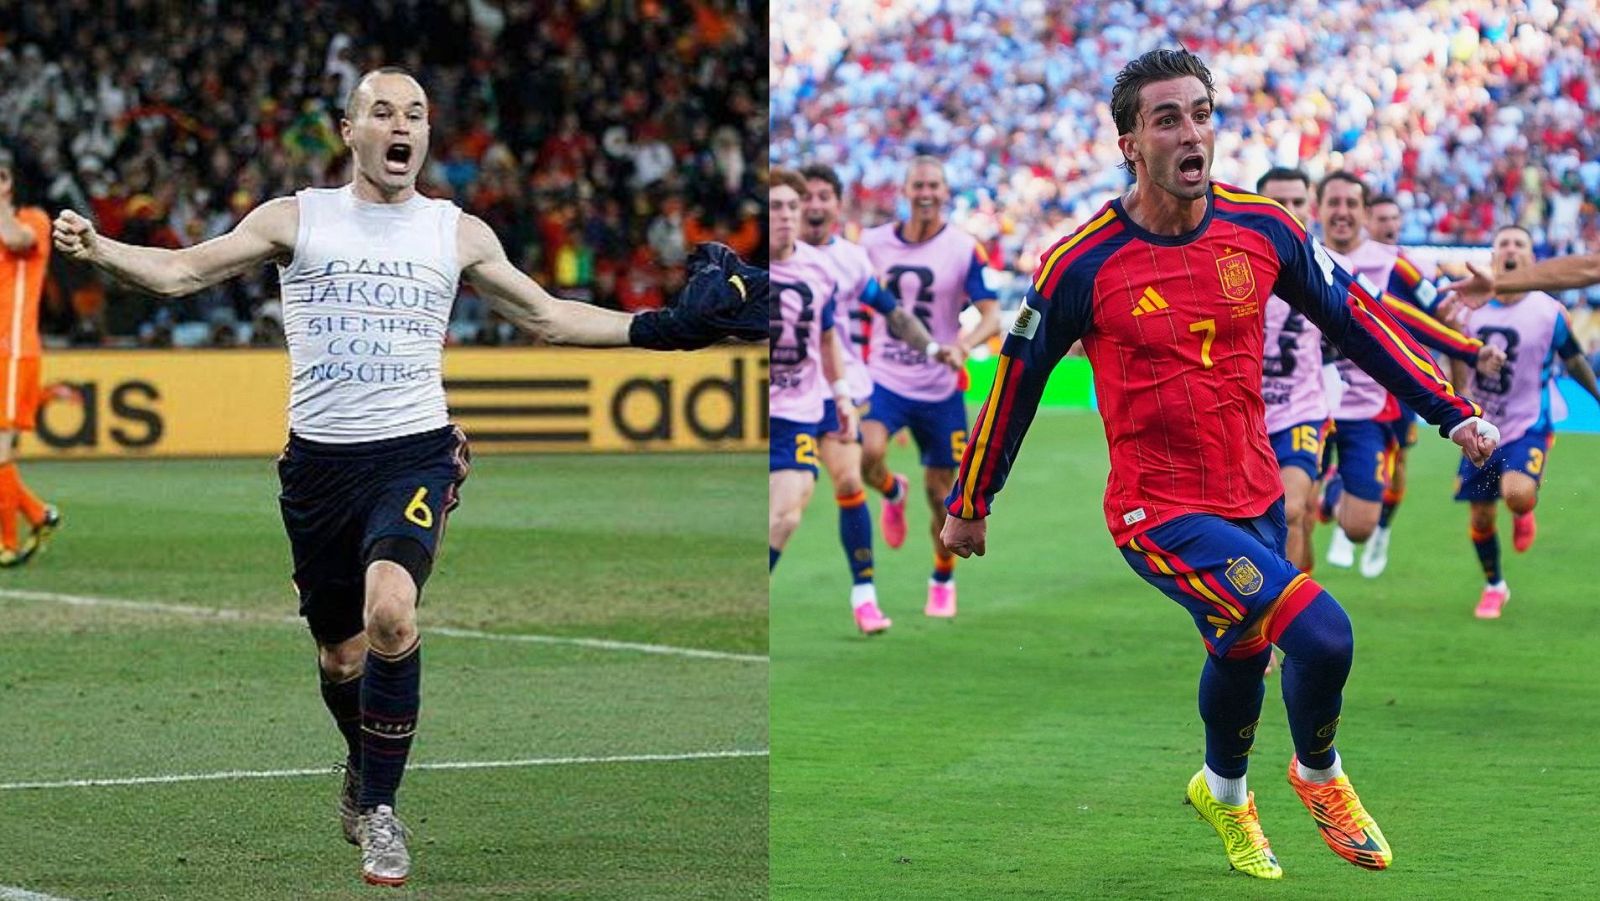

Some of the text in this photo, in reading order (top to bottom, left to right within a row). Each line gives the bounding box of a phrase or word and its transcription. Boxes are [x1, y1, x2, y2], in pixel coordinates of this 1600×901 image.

[325, 259, 413, 279] DANI
[302, 280, 438, 309] JARQUE
[308, 316, 434, 336] SIEMPRE
[327, 337, 392, 356] CON
[1189, 319, 1216, 369] 7
[310, 362, 432, 383] NOSOTROS
[611, 358, 769, 441] adi
[1291, 425, 1319, 454] 15
[1526, 447, 1544, 474] 3
[405, 486, 433, 527] 6
